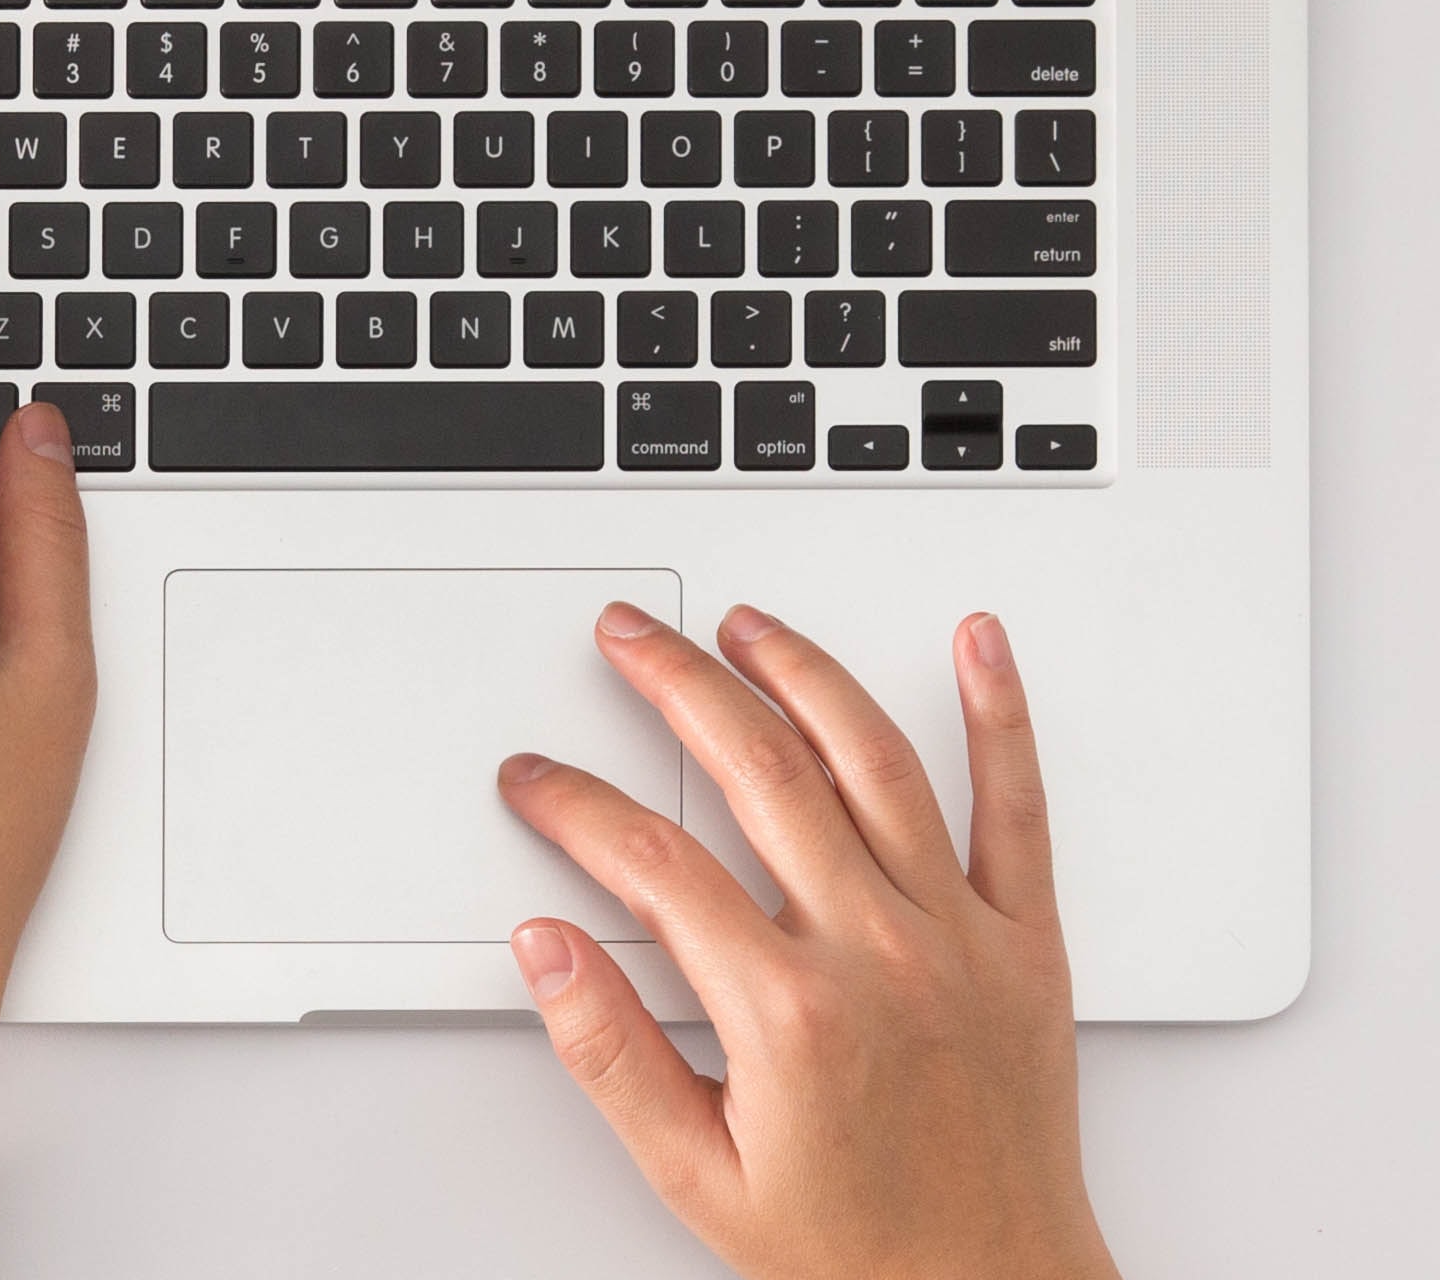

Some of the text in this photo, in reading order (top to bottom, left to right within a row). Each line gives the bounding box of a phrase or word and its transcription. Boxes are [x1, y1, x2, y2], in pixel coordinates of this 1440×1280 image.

[66, 32, 81, 53] #
[160, 31, 174, 54] $
[249, 32, 270, 53] %
[346, 32, 361, 46] ^
[438, 32, 455, 52] &
[632, 31, 638, 51] (
[725, 31, 731, 51] )
[908, 33, 924, 49] +
[66, 62, 80, 84] 3
[158, 61, 174, 84] 4
[252, 62, 266, 84] 5
[346, 62, 360, 83] 6
[440, 61, 454, 83] 7
[533, 60, 547, 82] 8
[628, 60, 642, 82] 9
[720, 61, 735, 83] 0
[1030, 65, 1079, 83] delete
[863, 119, 873, 142] {
[957, 119, 967, 142] }
[14, 137, 40, 160] W
[113, 136, 127, 160] E
[206, 136, 221, 159] R
[298, 136, 313, 159] T
[392, 136, 409, 159] Y
[485, 135, 504, 159] U
[585, 135, 591, 158] I
[671, 135, 692, 158] O
[767, 135, 783, 158] P
[865, 150, 872, 173] [
[958, 151, 965, 173] ]
[1046, 212, 1080, 223] enter
[41, 227, 56, 250] S
[134, 226, 152, 250] D
[229, 226, 243, 250] F
[319, 226, 339, 249] G
[414, 226, 433, 249] H
[511, 226, 523, 249] J
[603, 225, 620, 248] K
[698, 225, 712, 248] L
[1033, 247, 1081, 262] return
[650, 305, 665, 320] <
[745, 305, 760, 320] >
[839, 301, 852, 323] ?
[85, 316, 104, 339] X
[179, 316, 197, 340] C
[272, 316, 291, 339] V
[368, 316, 384, 339] B
[461, 316, 480, 340] N
[551, 316, 576, 339] M
[1048, 335, 1081, 352] shift
[788, 391, 805, 404] alt
[71, 441, 122, 457] mand
[631, 441, 709, 455] command
[756, 439, 806, 459] option
